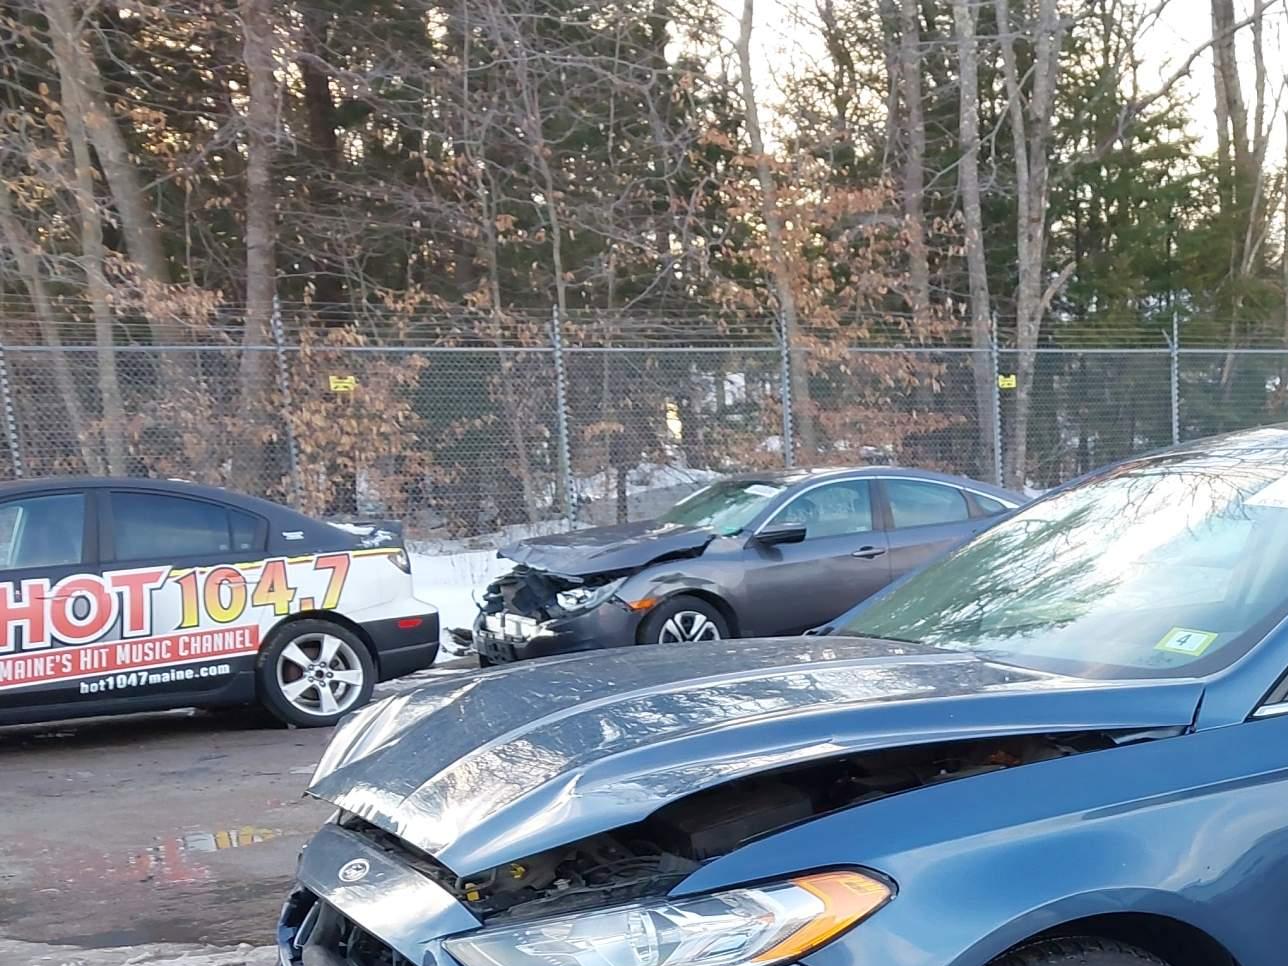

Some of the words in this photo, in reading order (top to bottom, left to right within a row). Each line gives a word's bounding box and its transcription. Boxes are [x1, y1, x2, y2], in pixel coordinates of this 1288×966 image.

[0, 565, 173, 652] HOT
[173, 552, 351, 631] 104.7
[0, 653, 73, 681] MAINE'S
[79, 648, 110, 671] HIT
[116, 640, 172, 665] MUSIC
[178, 629, 254, 657] CHANNEL
[1175, 633, 1193, 646] 4
[79, 663, 231, 694] hot1047maine.com
